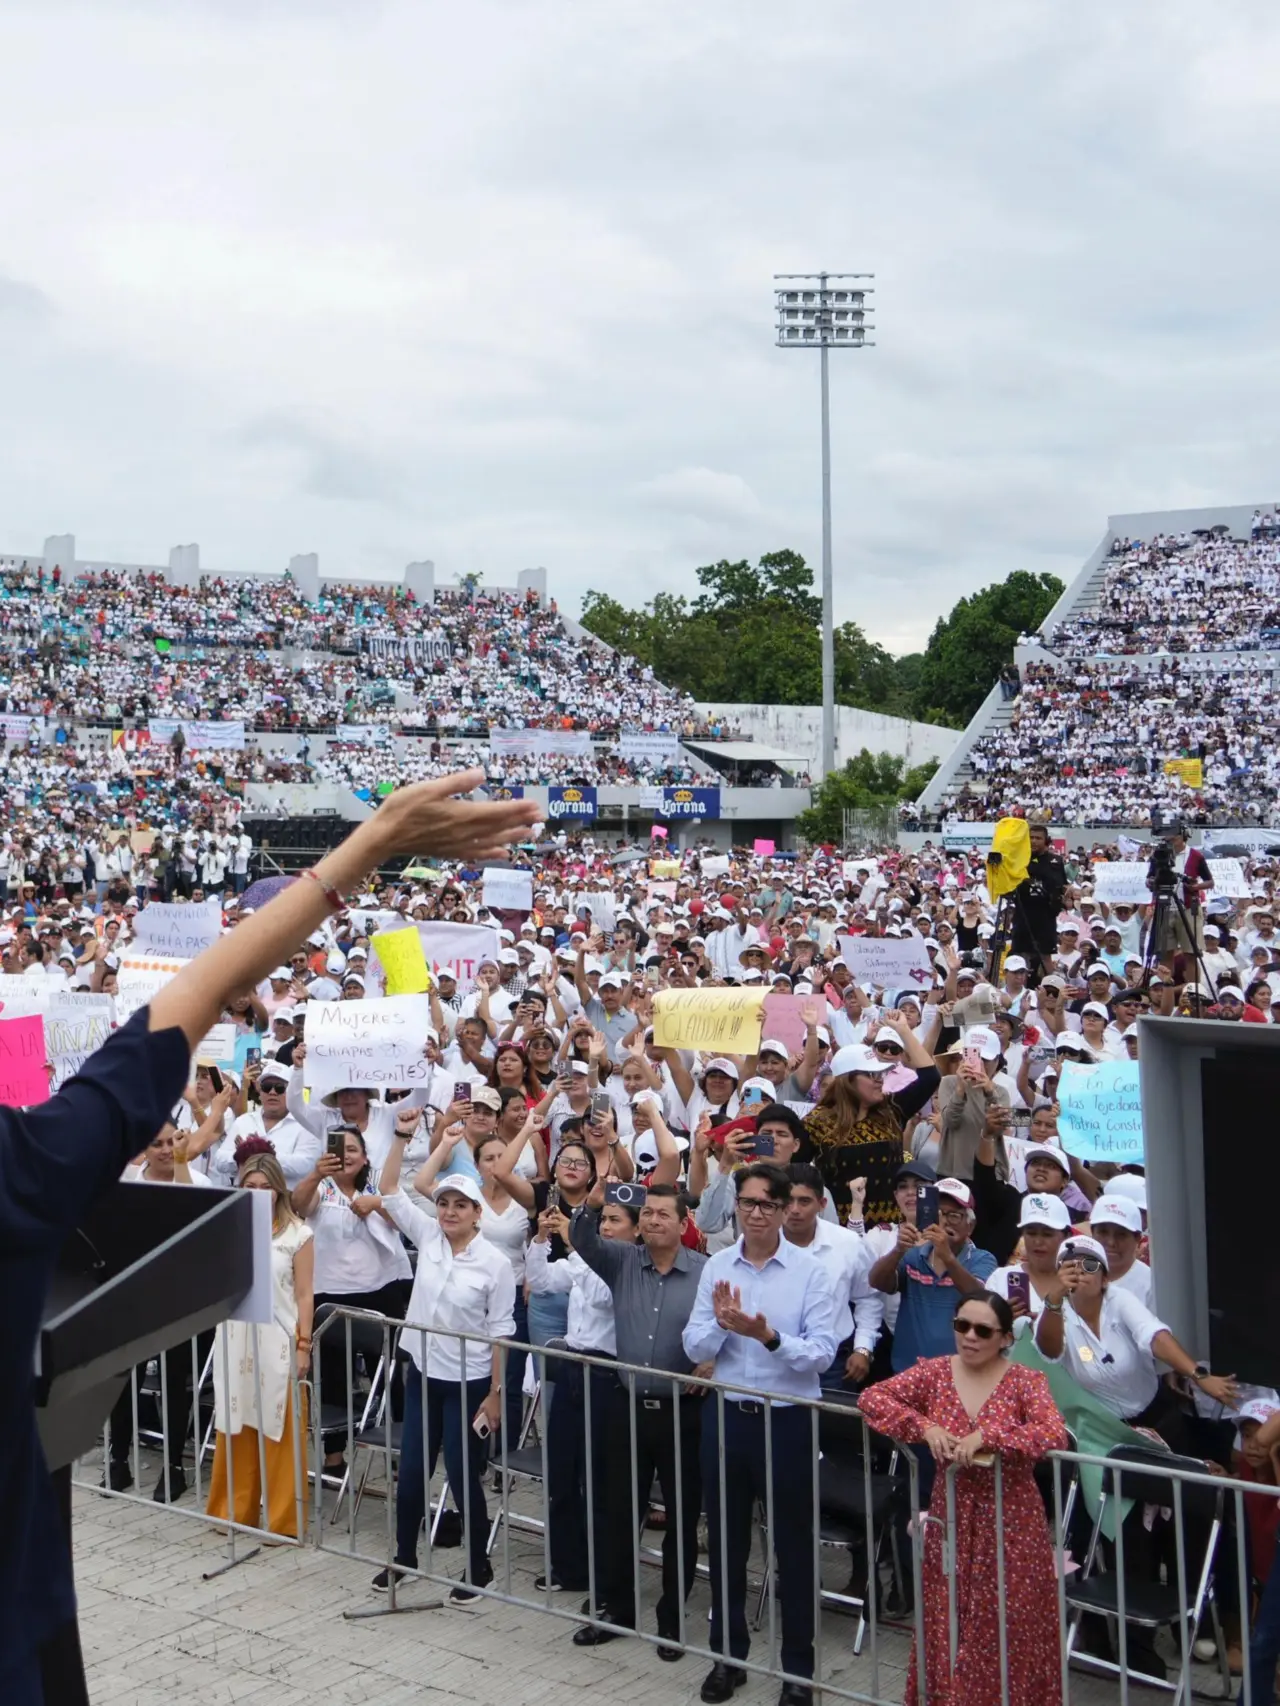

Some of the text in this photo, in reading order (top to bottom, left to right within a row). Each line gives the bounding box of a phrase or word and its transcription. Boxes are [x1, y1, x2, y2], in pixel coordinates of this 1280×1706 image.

[549, 800, 593, 817] Corona
[659, 799, 707, 818] Corona
[663, 1013, 727, 1042] CLAUDIA
[20, 1030, 41, 1057] LA
[340, 1060, 427, 1083] PRESENTES
[1068, 1114, 1100, 1131] Patria
